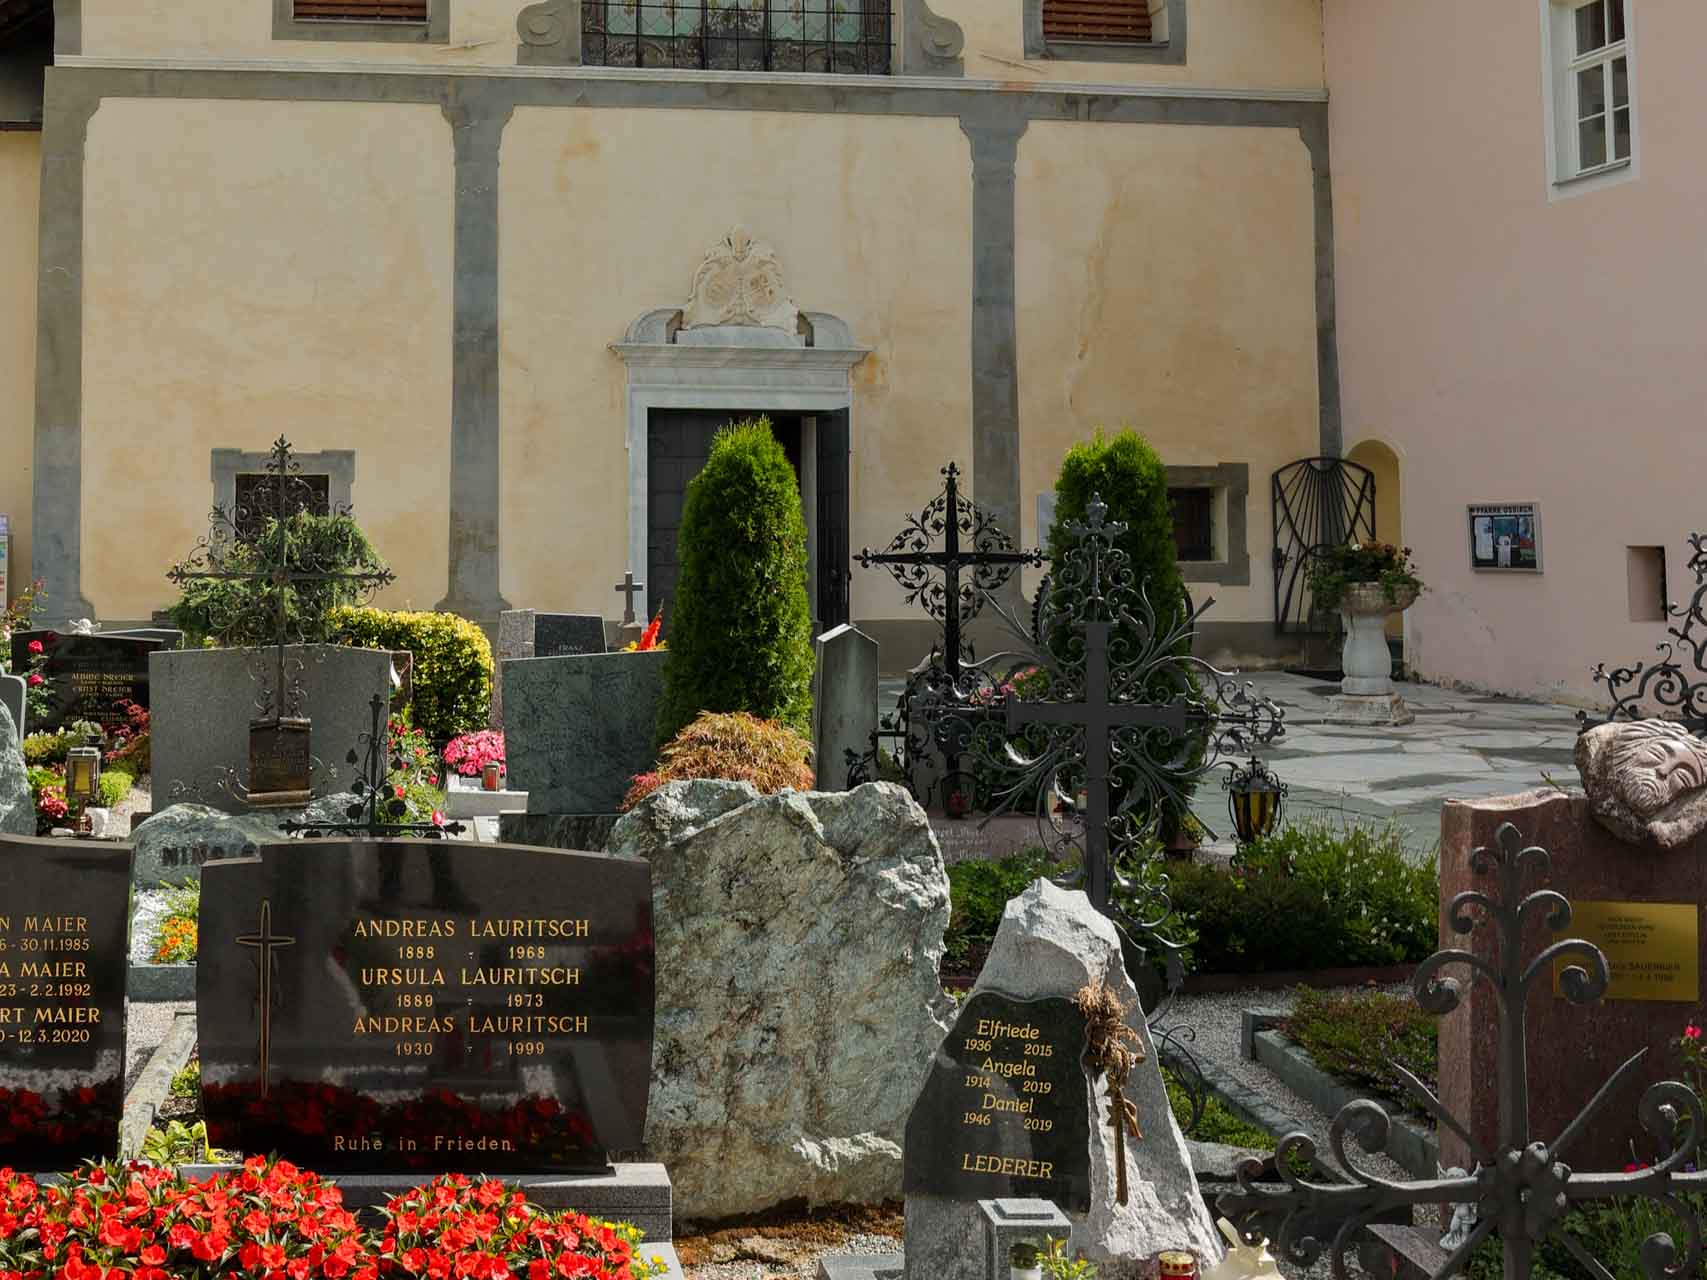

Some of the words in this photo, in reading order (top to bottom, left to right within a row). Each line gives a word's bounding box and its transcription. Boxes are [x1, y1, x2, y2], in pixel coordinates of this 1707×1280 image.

[24, 916, 88, 932] MAIER
[354, 919, 455, 937] ANDREAS
[471, 919, 589, 937] LAURITSCH
[20, 938, 90, 952] 30.11.1985
[399, 945, 435, 959] 1888
[509, 946, 546, 959] 1968
[20, 962, 86, 977] MAIER
[362, 968, 446, 985] URSULA
[461, 968, 579, 985] LAURITSCH
[30, 983, 91, 997] 2.2.1992
[397, 994, 433, 1008] 1889
[507, 993, 544, 1007] 1973
[33, 1007, 101, 1023] MAIER
[353, 1017, 454, 1033] ANDREAS
[469, 1016, 589, 1033] LAURITSCH
[977, 1019, 1040, 1040] Elfriede
[19, 1029, 90, 1043] 12.3.2020
[396, 1042, 433, 1056] 1930
[508, 1042, 545, 1056] 1999
[965, 1038, 992, 1052] 1936
[1024, 1043, 1053, 1057] 2015
[981, 1056, 1037, 1078] Angela
[965, 1075, 992, 1089] 1914
[1023, 1080, 1052, 1094] 2019
[982, 1093, 1034, 1114] Daniel
[964, 1112, 991, 1126] 1946
[1024, 1118, 1053, 1132] 2019
[334, 1135, 383, 1152] Ruhe
[399, 1135, 417, 1151] in
[963, 1153, 1053, 1178] LEDERER
